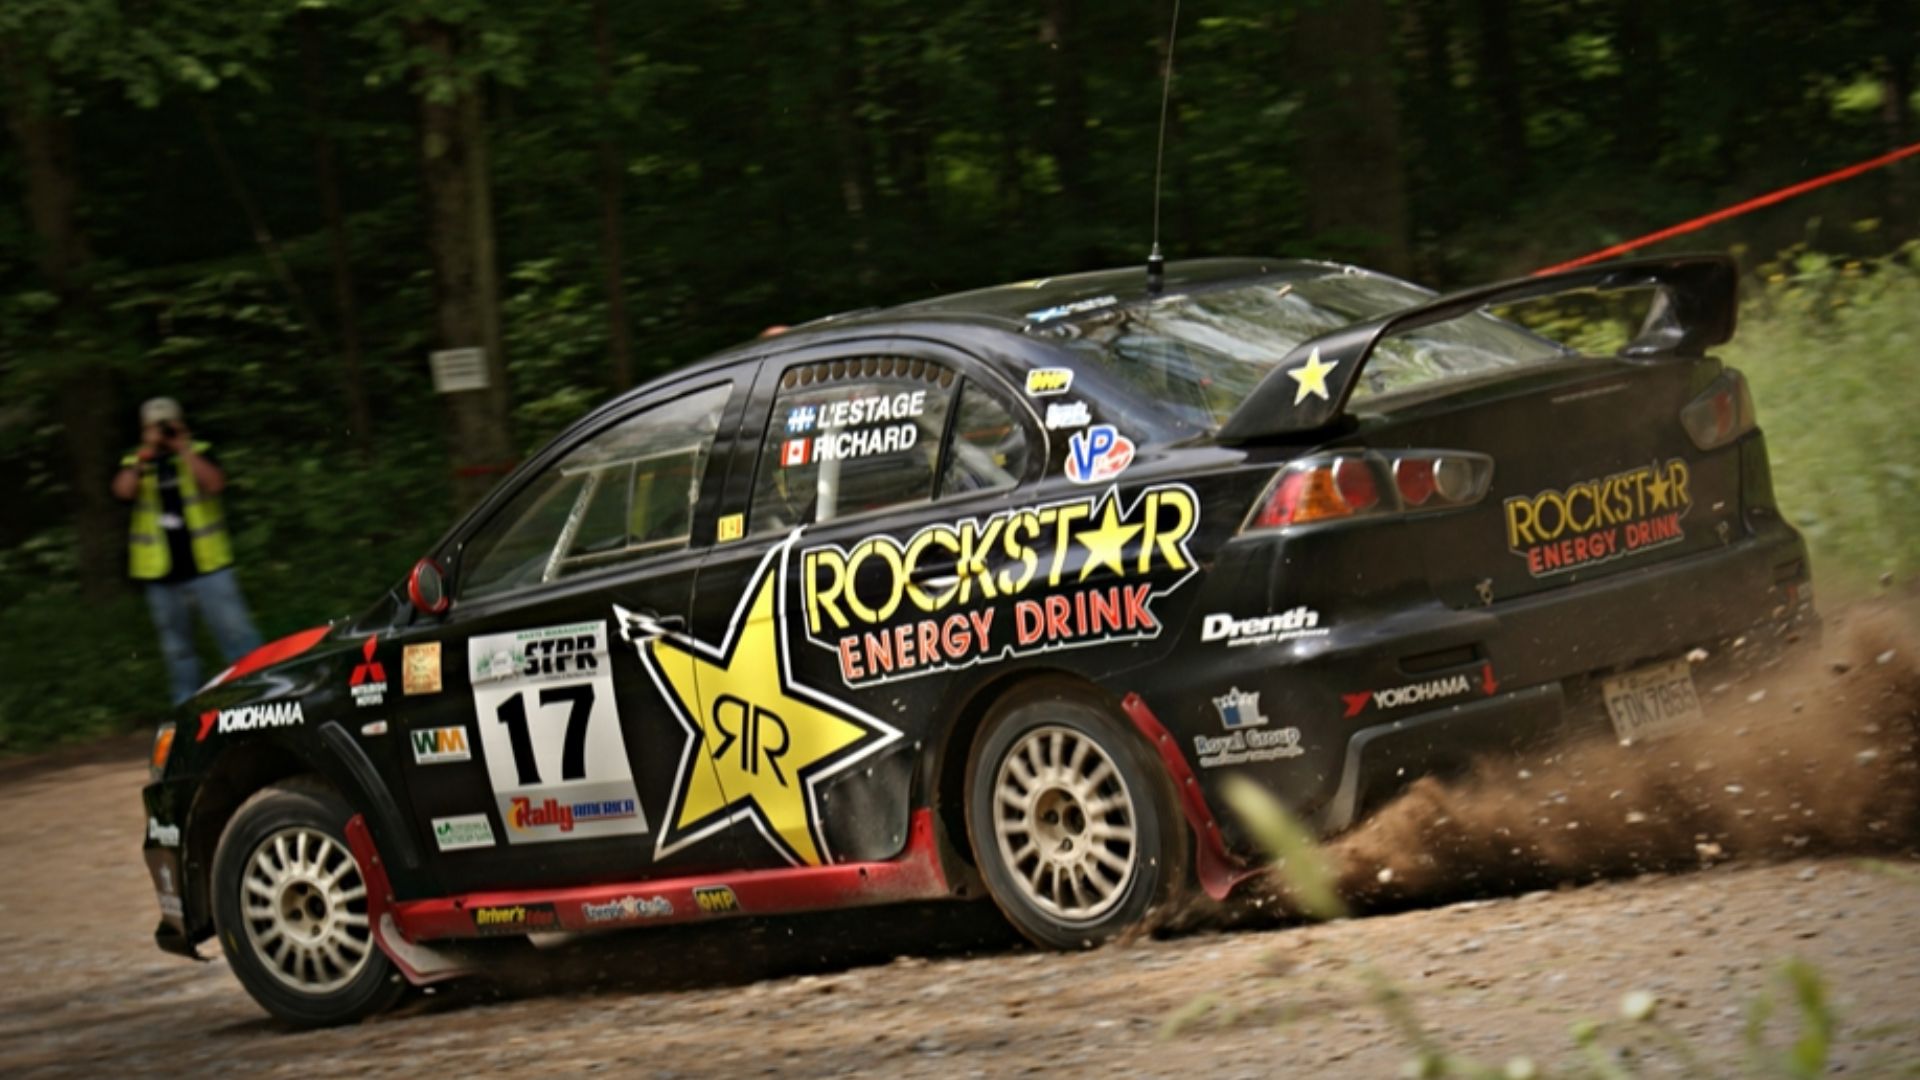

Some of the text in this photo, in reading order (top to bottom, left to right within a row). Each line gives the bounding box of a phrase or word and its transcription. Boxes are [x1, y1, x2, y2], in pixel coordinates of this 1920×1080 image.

[817, 390, 926, 429] L'ESTAGE
[812, 423, 918, 463] RICHARD
[1072, 428, 1114, 481] VP
[1528, 512, 1682, 573] ENERGY DRINK
[839, 584, 1156, 680] ENERGY DRINK
[1201, 606, 1319, 641] Drenth
[523, 634, 598, 676] STPR
[1373, 675, 1470, 710] YOKOHAMA
[218, 702, 304, 733] YOKOHAMA
[496, 683, 595, 786] 17
[413, 727, 466, 754] WM
[1194, 730, 1246, 759] Royal
[1246, 727, 1302, 752] Group
[510, 796, 574, 832] Rally
